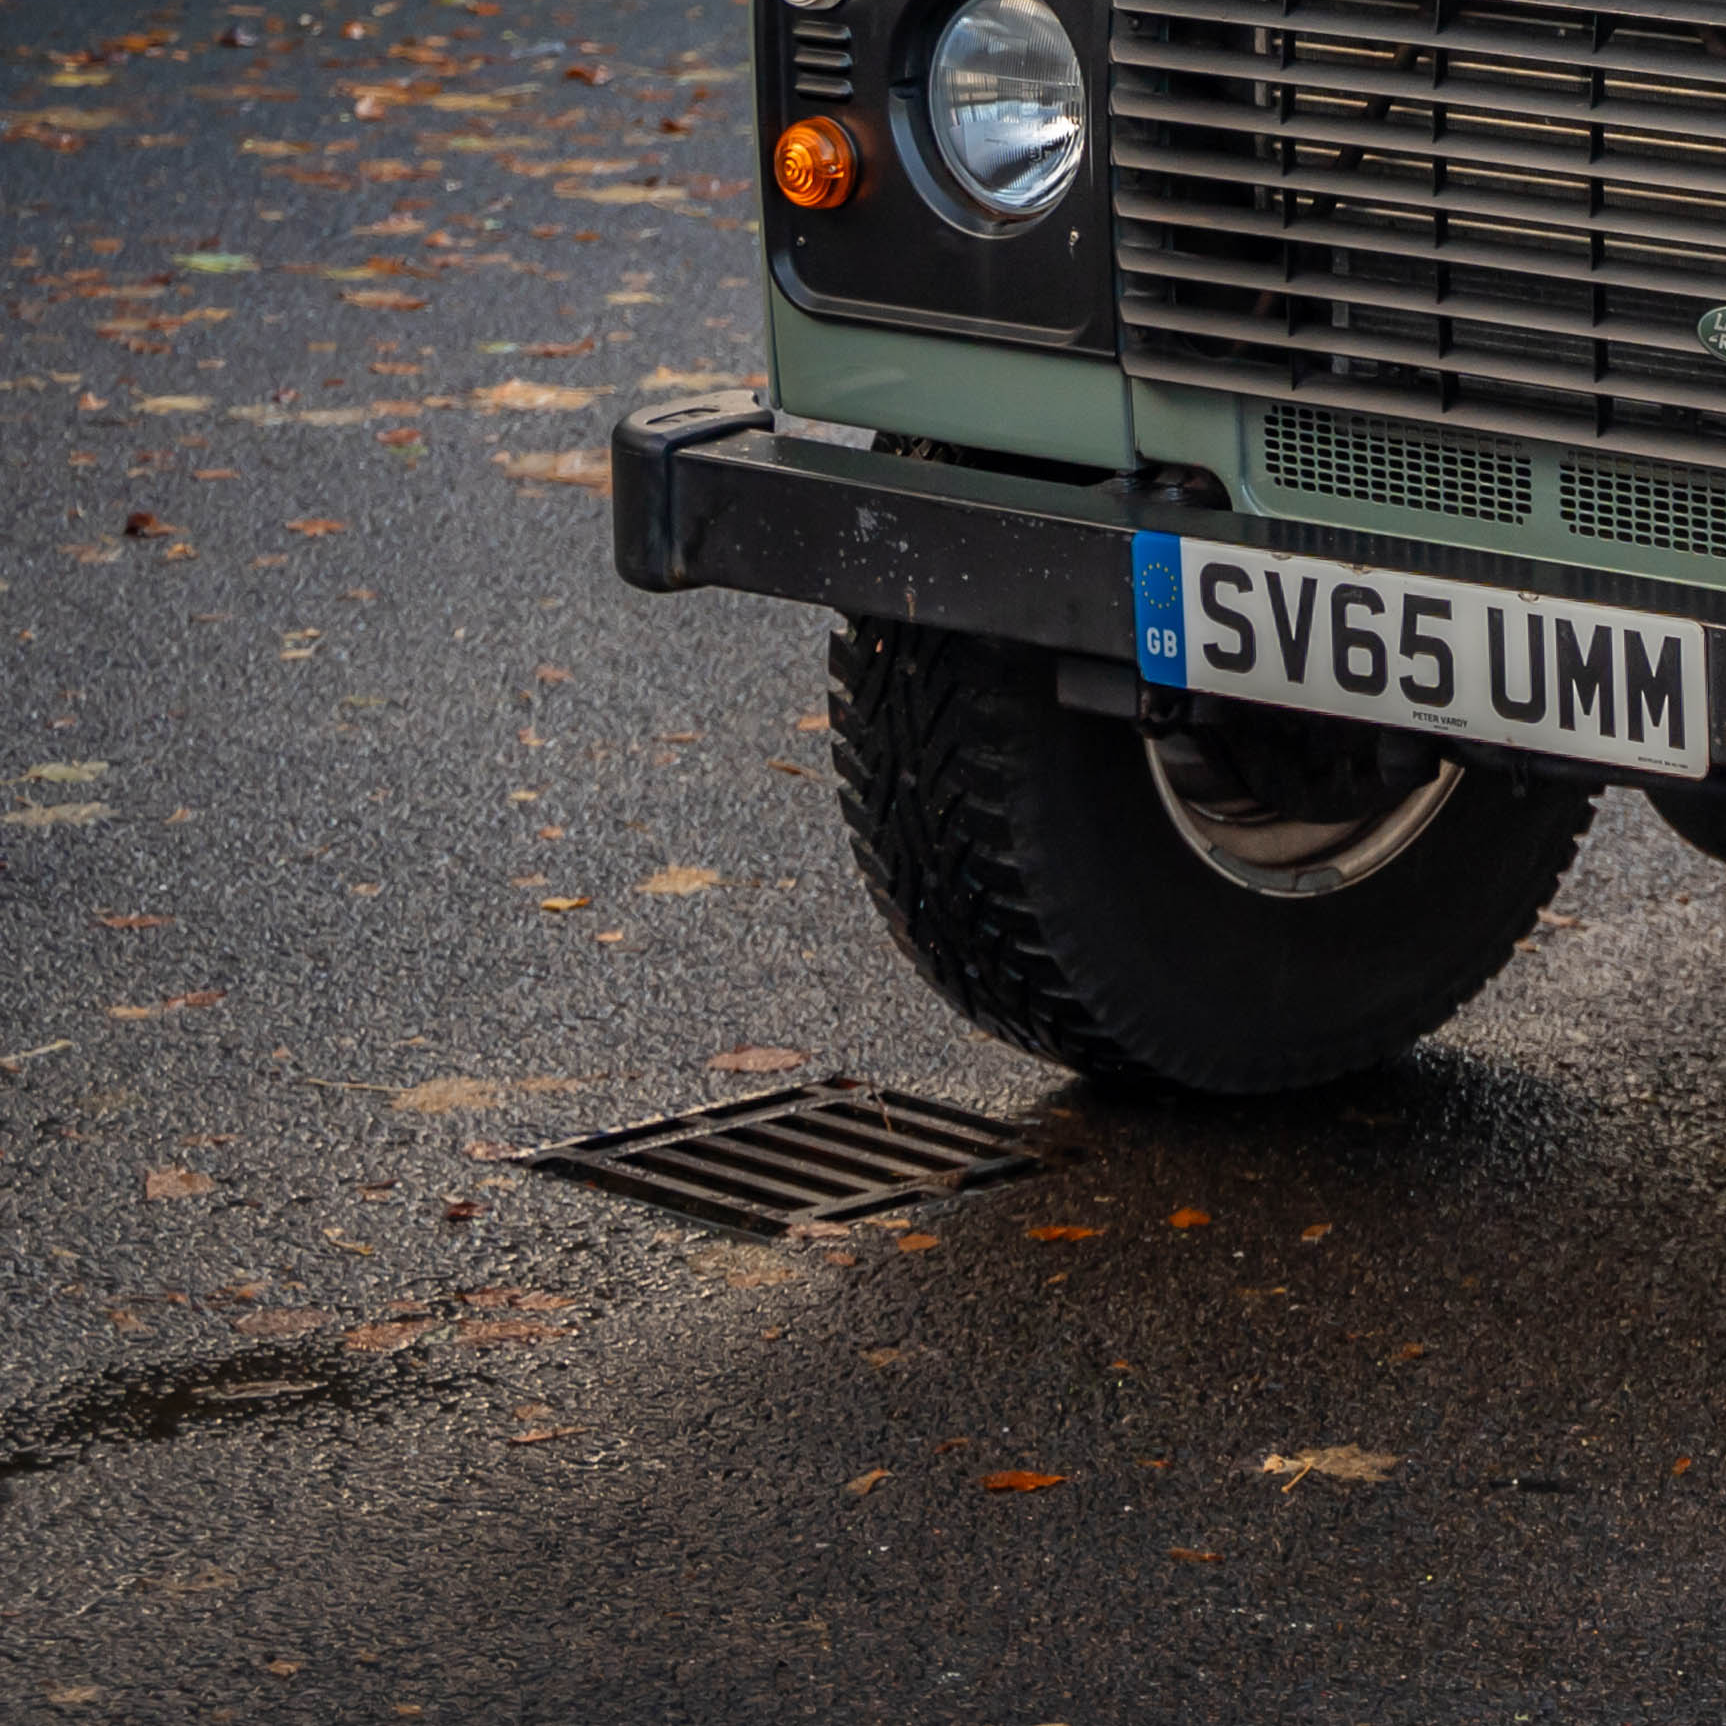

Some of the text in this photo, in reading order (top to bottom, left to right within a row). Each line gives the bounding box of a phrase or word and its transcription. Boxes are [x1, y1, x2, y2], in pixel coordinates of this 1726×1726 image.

[1146, 626, 1179, 659] GB
[1198, 561, 1687, 751] SV65 UMM
[1412, 710, 1439, 724] PETER
[1440, 715, 1469, 728] VARDY
